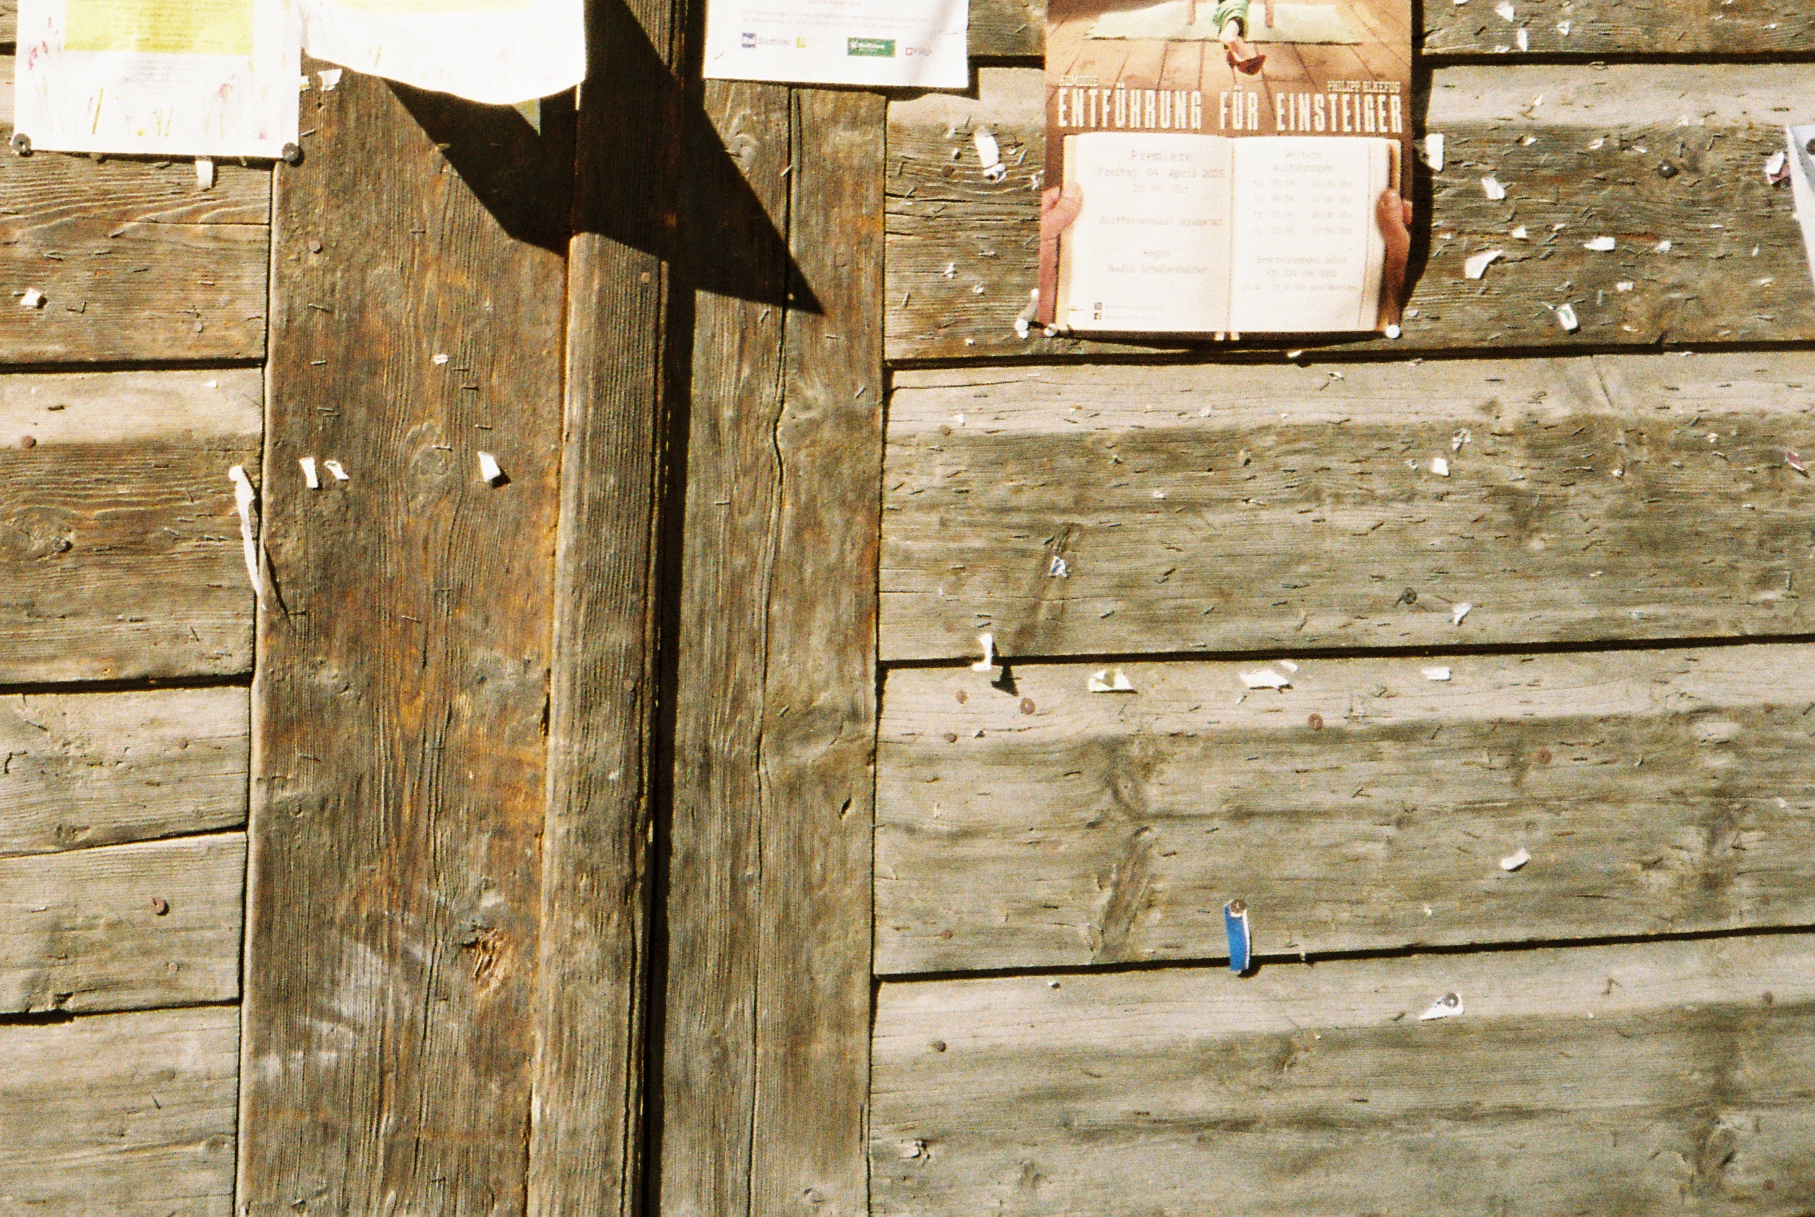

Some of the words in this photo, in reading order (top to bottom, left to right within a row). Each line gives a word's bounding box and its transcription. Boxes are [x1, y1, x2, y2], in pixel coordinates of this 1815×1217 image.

[1056, 83, 1203, 129] ENTFÜHRUNG
[1219, 85, 1260, 131] FÜR
[1276, 92, 1403, 134] EINSTEIGER
[1131, 149, 1194, 162] Premiere
